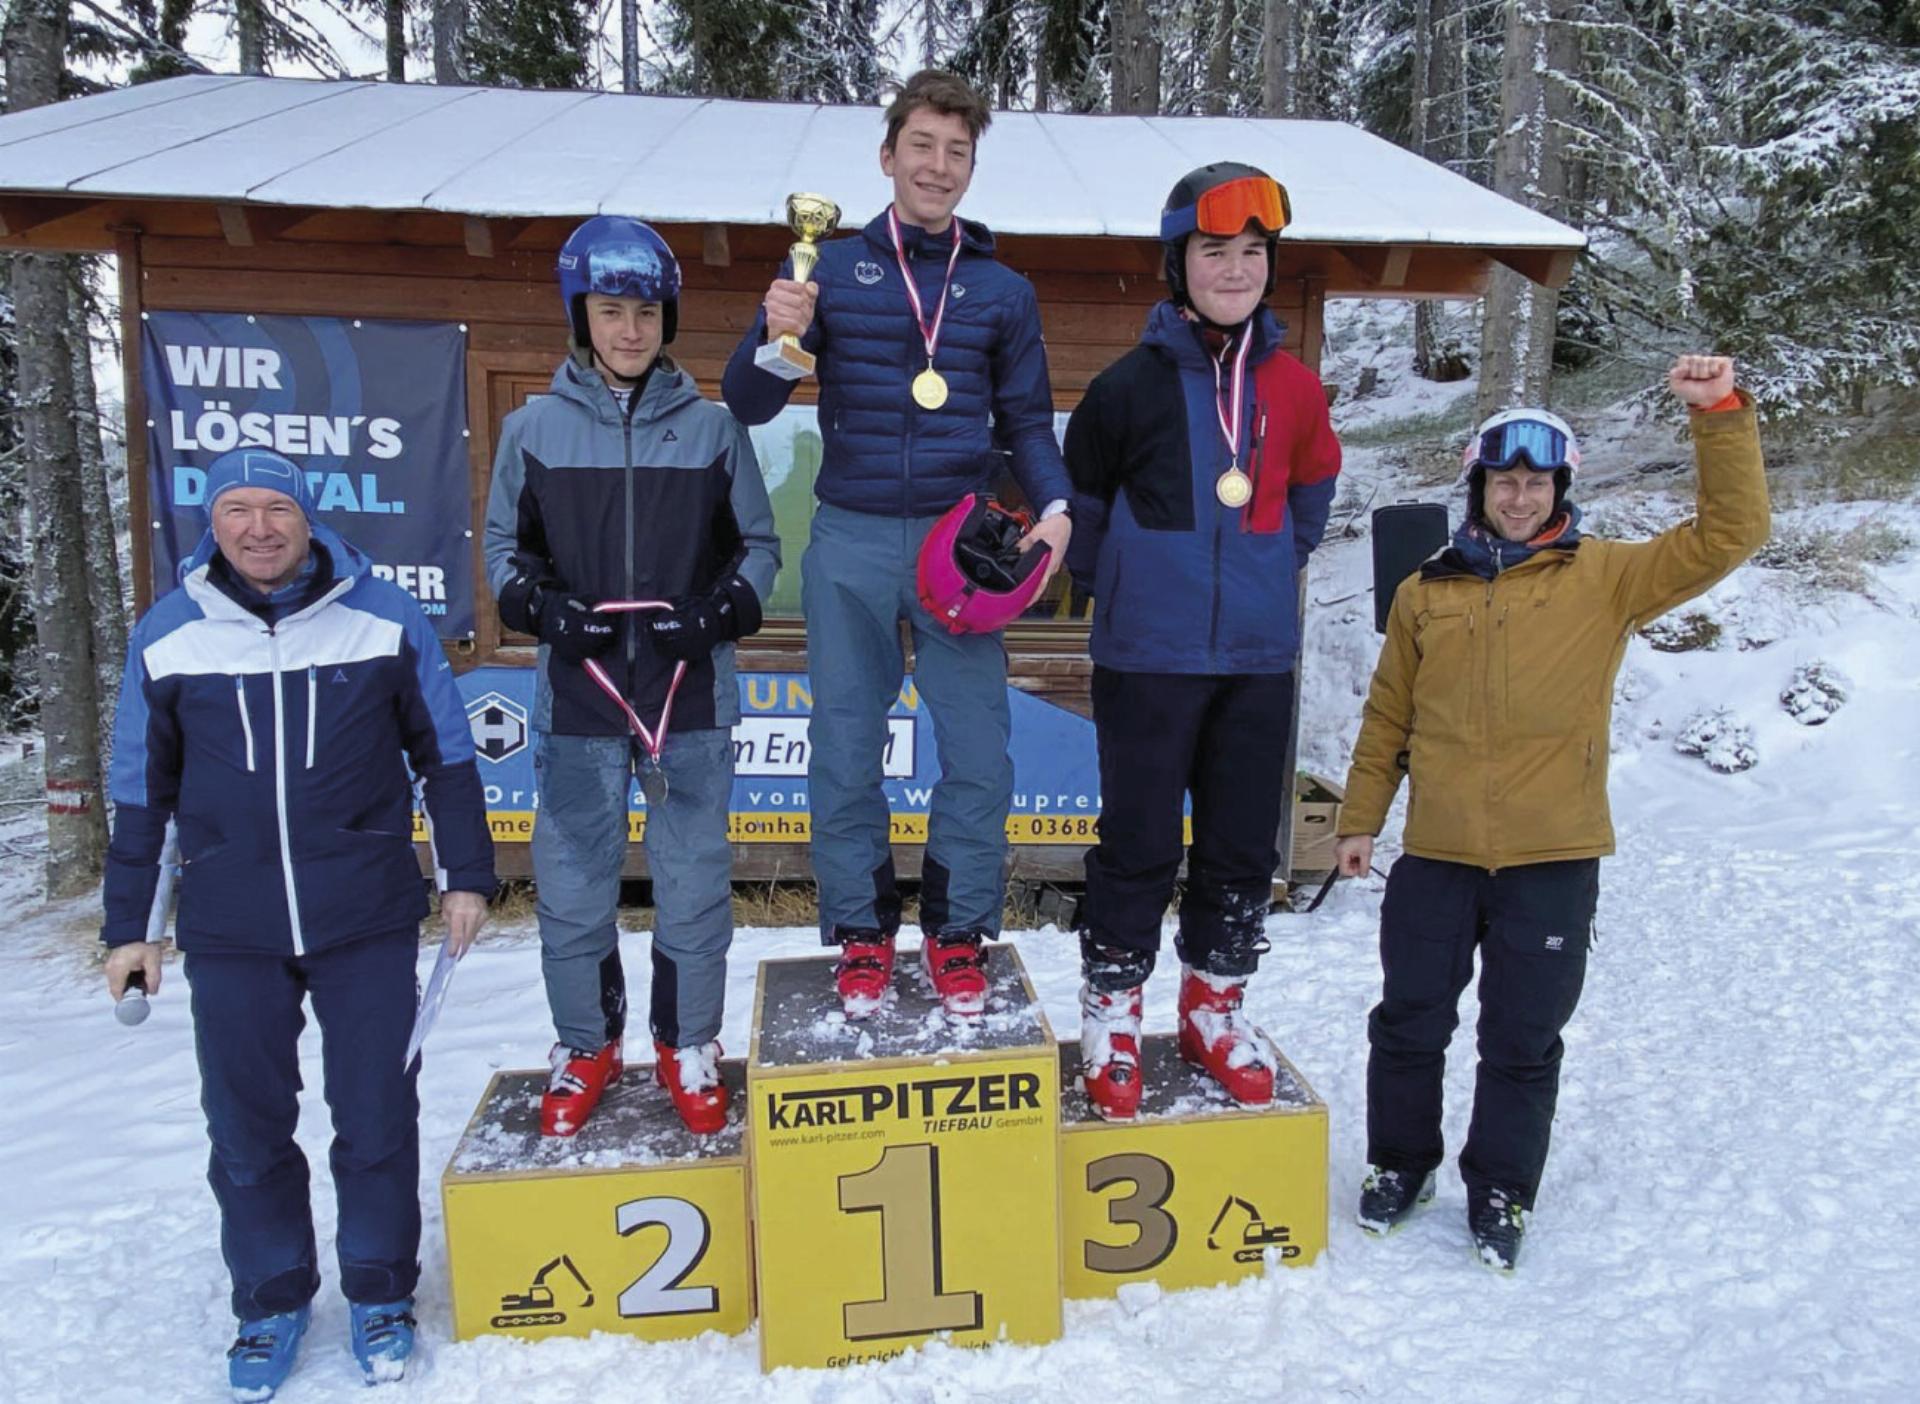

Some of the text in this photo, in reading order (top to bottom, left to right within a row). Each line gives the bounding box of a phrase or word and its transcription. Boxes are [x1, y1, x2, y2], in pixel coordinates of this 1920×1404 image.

[166, 345, 282, 391] WIR
[749, 792, 807, 806] von
[861, 1072, 1042, 1123] PITZER
[768, 1129, 887, 1148] www.karl-pitzer.com
[923, 1115, 1044, 1134] TIEFBAU GesmbH
[1084, 1152, 1179, 1274] 3
[615, 1195, 720, 1319] 2
[837, 1142, 984, 1342] 1
